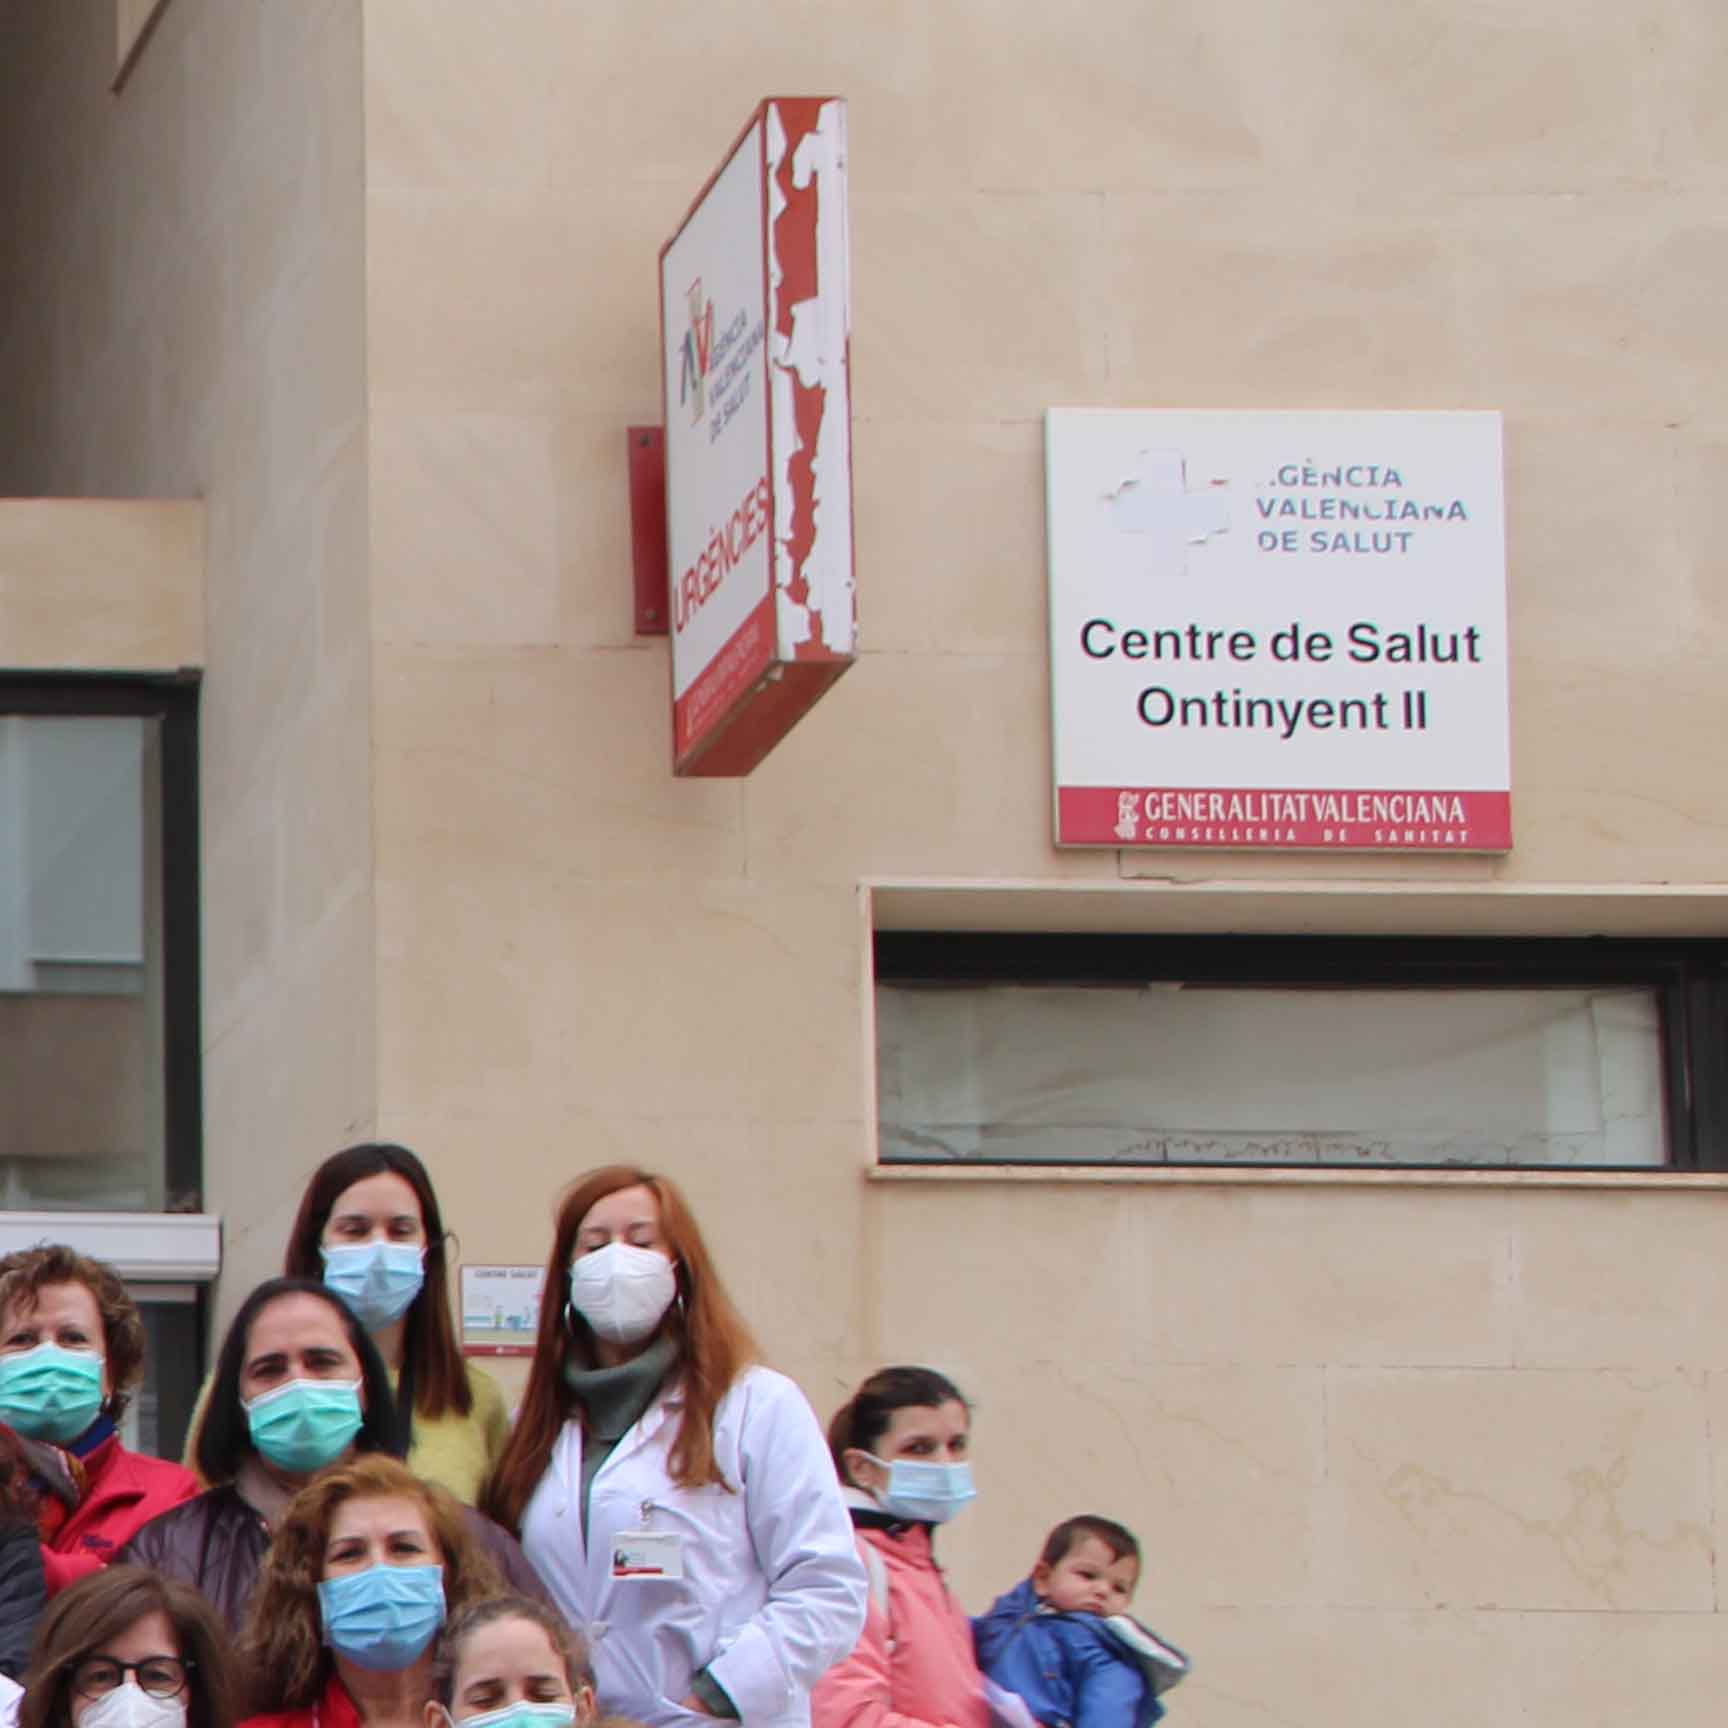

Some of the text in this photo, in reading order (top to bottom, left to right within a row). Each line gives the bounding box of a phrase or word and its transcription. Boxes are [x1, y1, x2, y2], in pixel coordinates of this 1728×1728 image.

[1256, 458, 1402, 488] GÈNCIA
[674, 477, 768, 633] URGÈNCIES
[1258, 531, 1413, 554] DE SALUT
[1080, 619, 1481, 665] Centre de Salut
[1136, 687, 1428, 740] Ontinyent II
